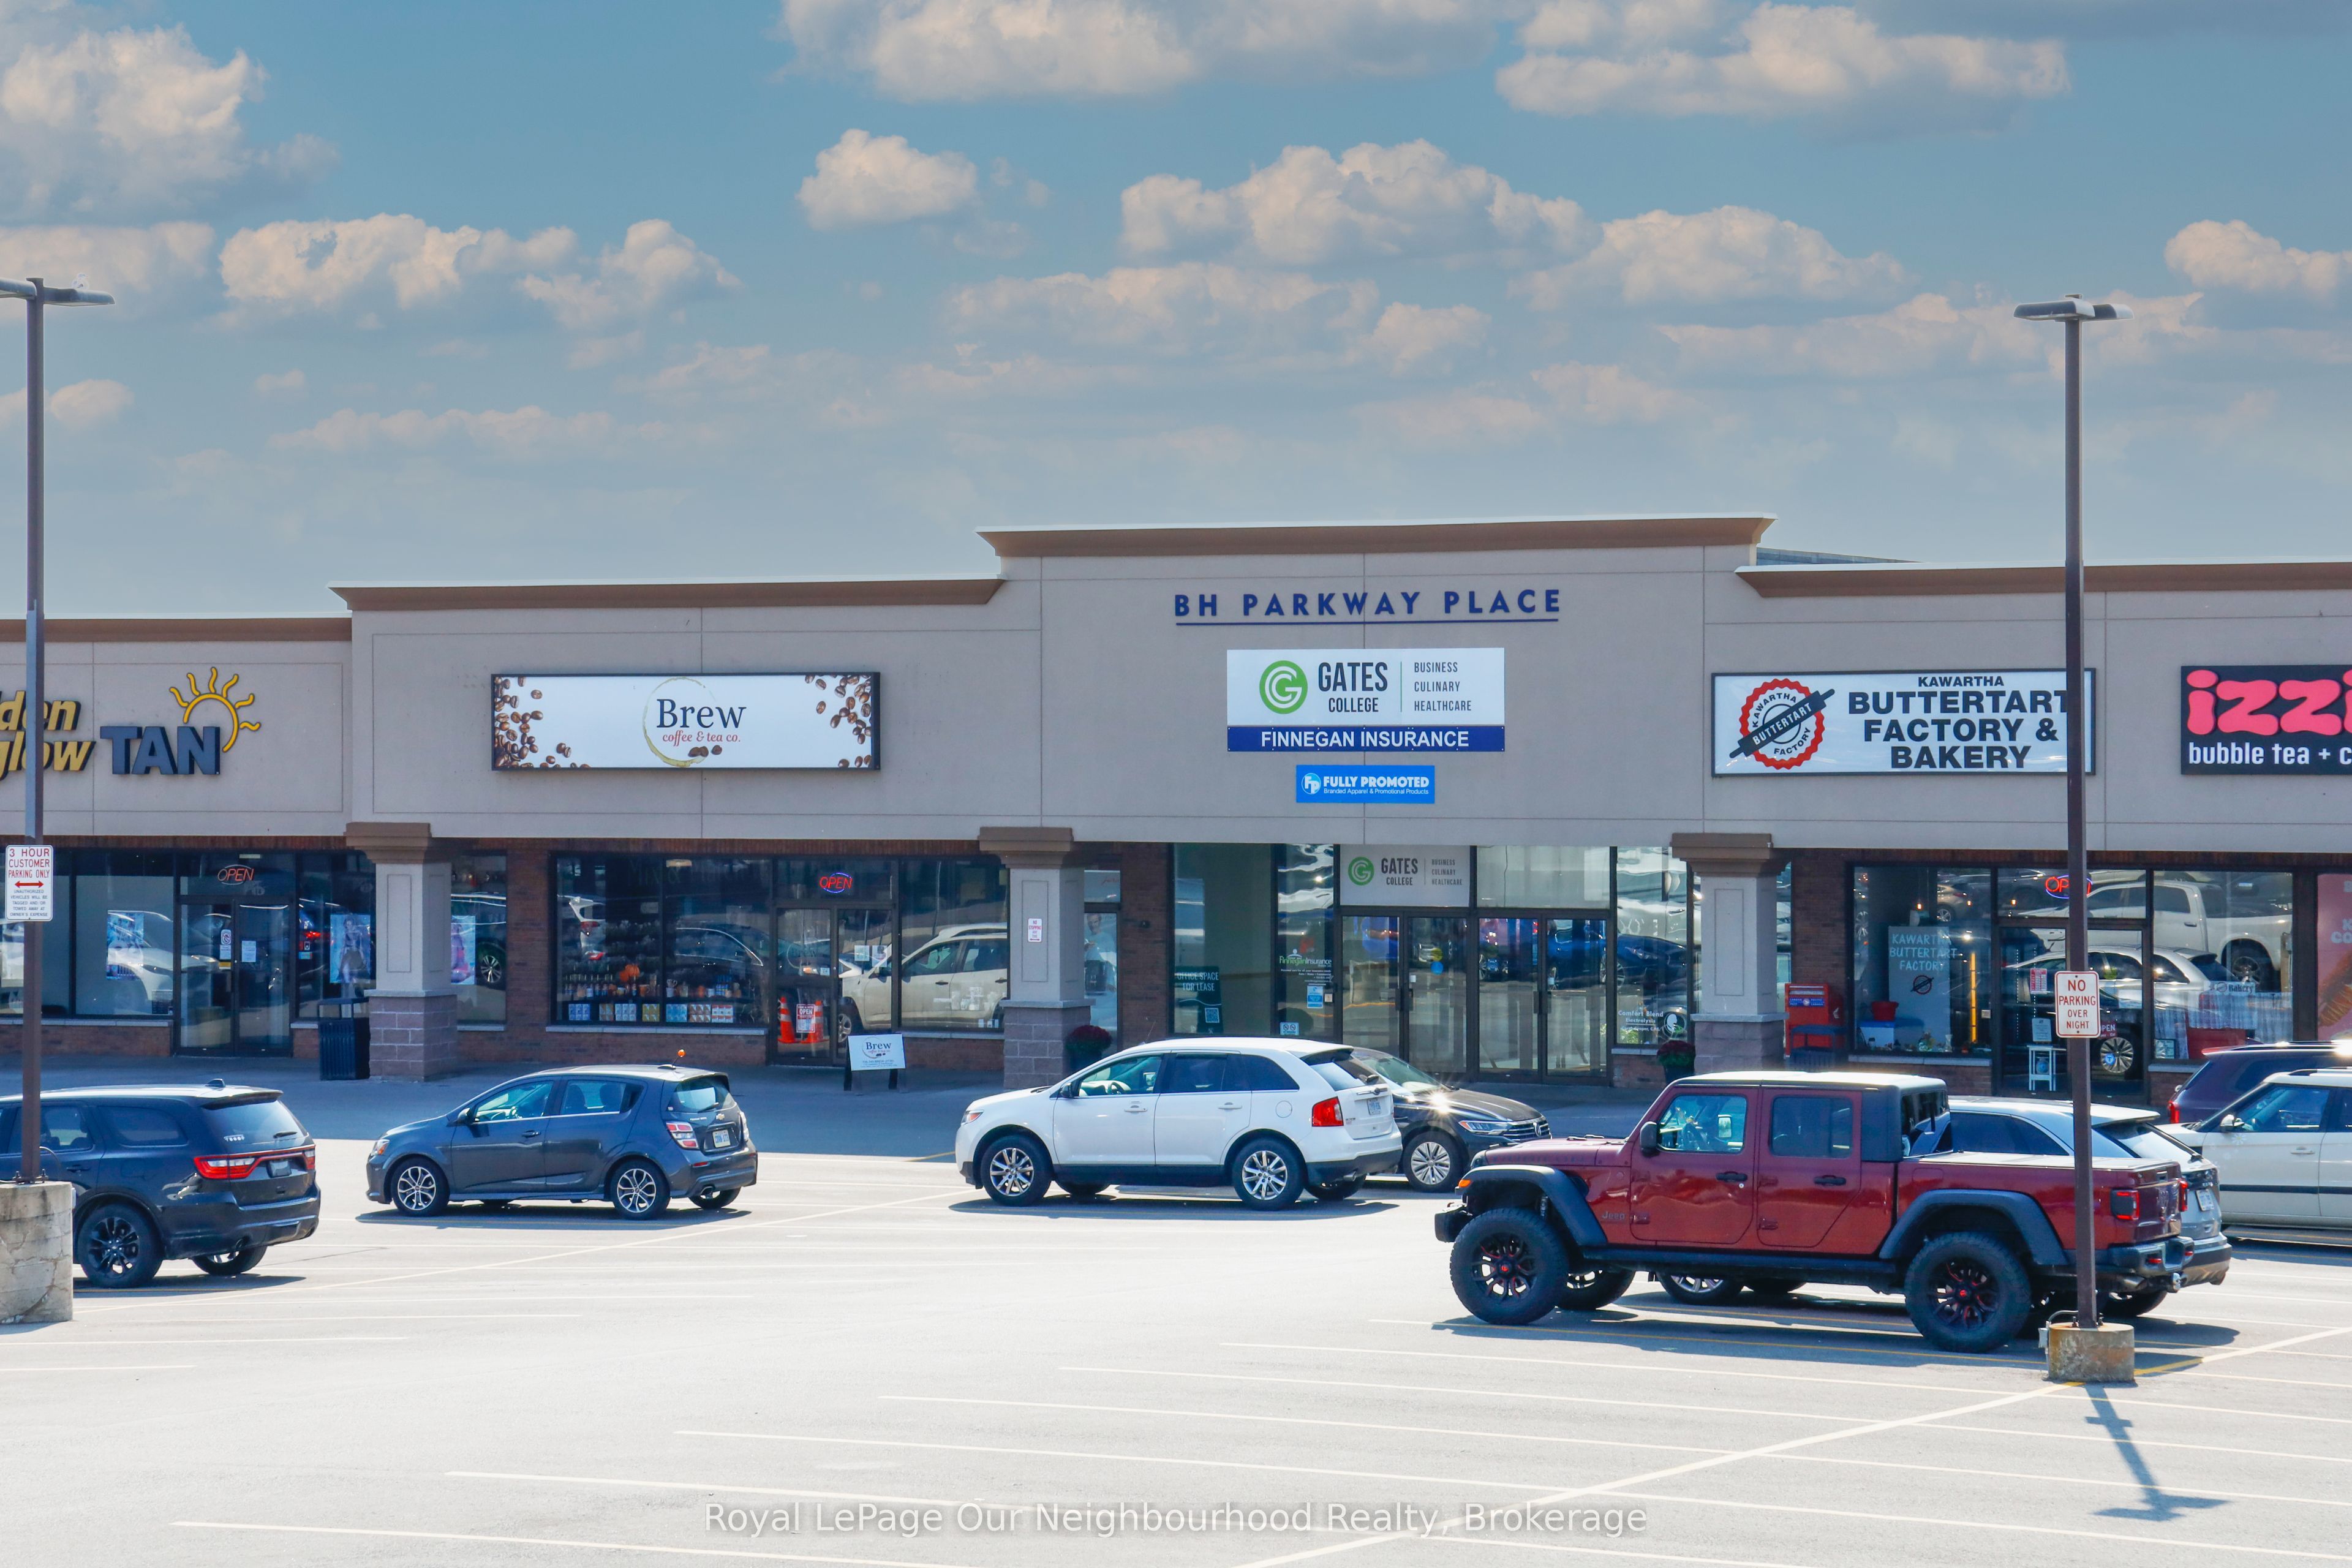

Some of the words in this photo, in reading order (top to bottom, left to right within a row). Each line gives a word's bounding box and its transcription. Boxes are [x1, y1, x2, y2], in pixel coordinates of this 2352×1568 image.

[1175, 594, 1217, 616] BH
[1243, 592, 1420, 616] PARKWAY
[1444, 589, 1560, 612] PLACE
[1414, 662, 1458, 673] BUSINESS
[1318, 662, 1388, 692] GATES
[1918, 676, 2004, 687] KAWARTHA
[1414, 681, 1460, 692] CULINARY
[1329, 697, 1379, 712] COLLEGE
[1414, 700, 1471, 711] HEALTHCARE
[1849, 690, 2067, 714] BUTTERTART
[657, 699, 747, 728] Brew
[1752, 693, 1796, 727] KAWARTHA
[1752, 703, 1812, 745] BUTTERTART
[1864, 718, 2024, 742] FACTORY
[2035, 717, 2059, 742] &
[662, 729, 693, 747] coffee
[696, 731, 705, 742] &
[707, 732, 723, 742] tea
[726, 733, 741, 742] co.
[1261, 731, 1355, 747] FINNEGAN
[1361, 731, 1469, 747] INSURANCE
[1774, 727, 1811, 755] FACTORY
[100, 726, 220, 774] TAN
[2188, 742, 2264, 764] bubble
[2272, 743, 2310, 764] tea
[1891, 745, 2032, 769] BAKERY
[1324, 777, 1358, 787] FULLY
[1361, 777, 1429, 788] PROMOTED
[10, 848, 15, 857] 3
[22, 848, 50, 857] HOUR
[1381, 858, 1418, 875] GATES
[8, 870, 32, 878] PARKING
[36, 870, 50, 878] ONLY
[217, 868, 255, 881] OPEN
[820, 876, 853, 889] OPEN
[2045, 876, 2092, 897] OP
[1892, 933, 1951, 945] KAWARTHA
[1890, 947, 1958, 959] BUTTERTART
[1900, 960, 1945, 971] FACTORY
[1200, 972, 1219, 981] SPACE
[2068, 979, 2086, 991] NO
[2229, 984, 2253, 993] Bakery
[2059, 996, 2096, 1005] PARKING
[2100, 1023, 2116, 1032] PEN
[1602, 1211, 1625, 1221] Jeep
